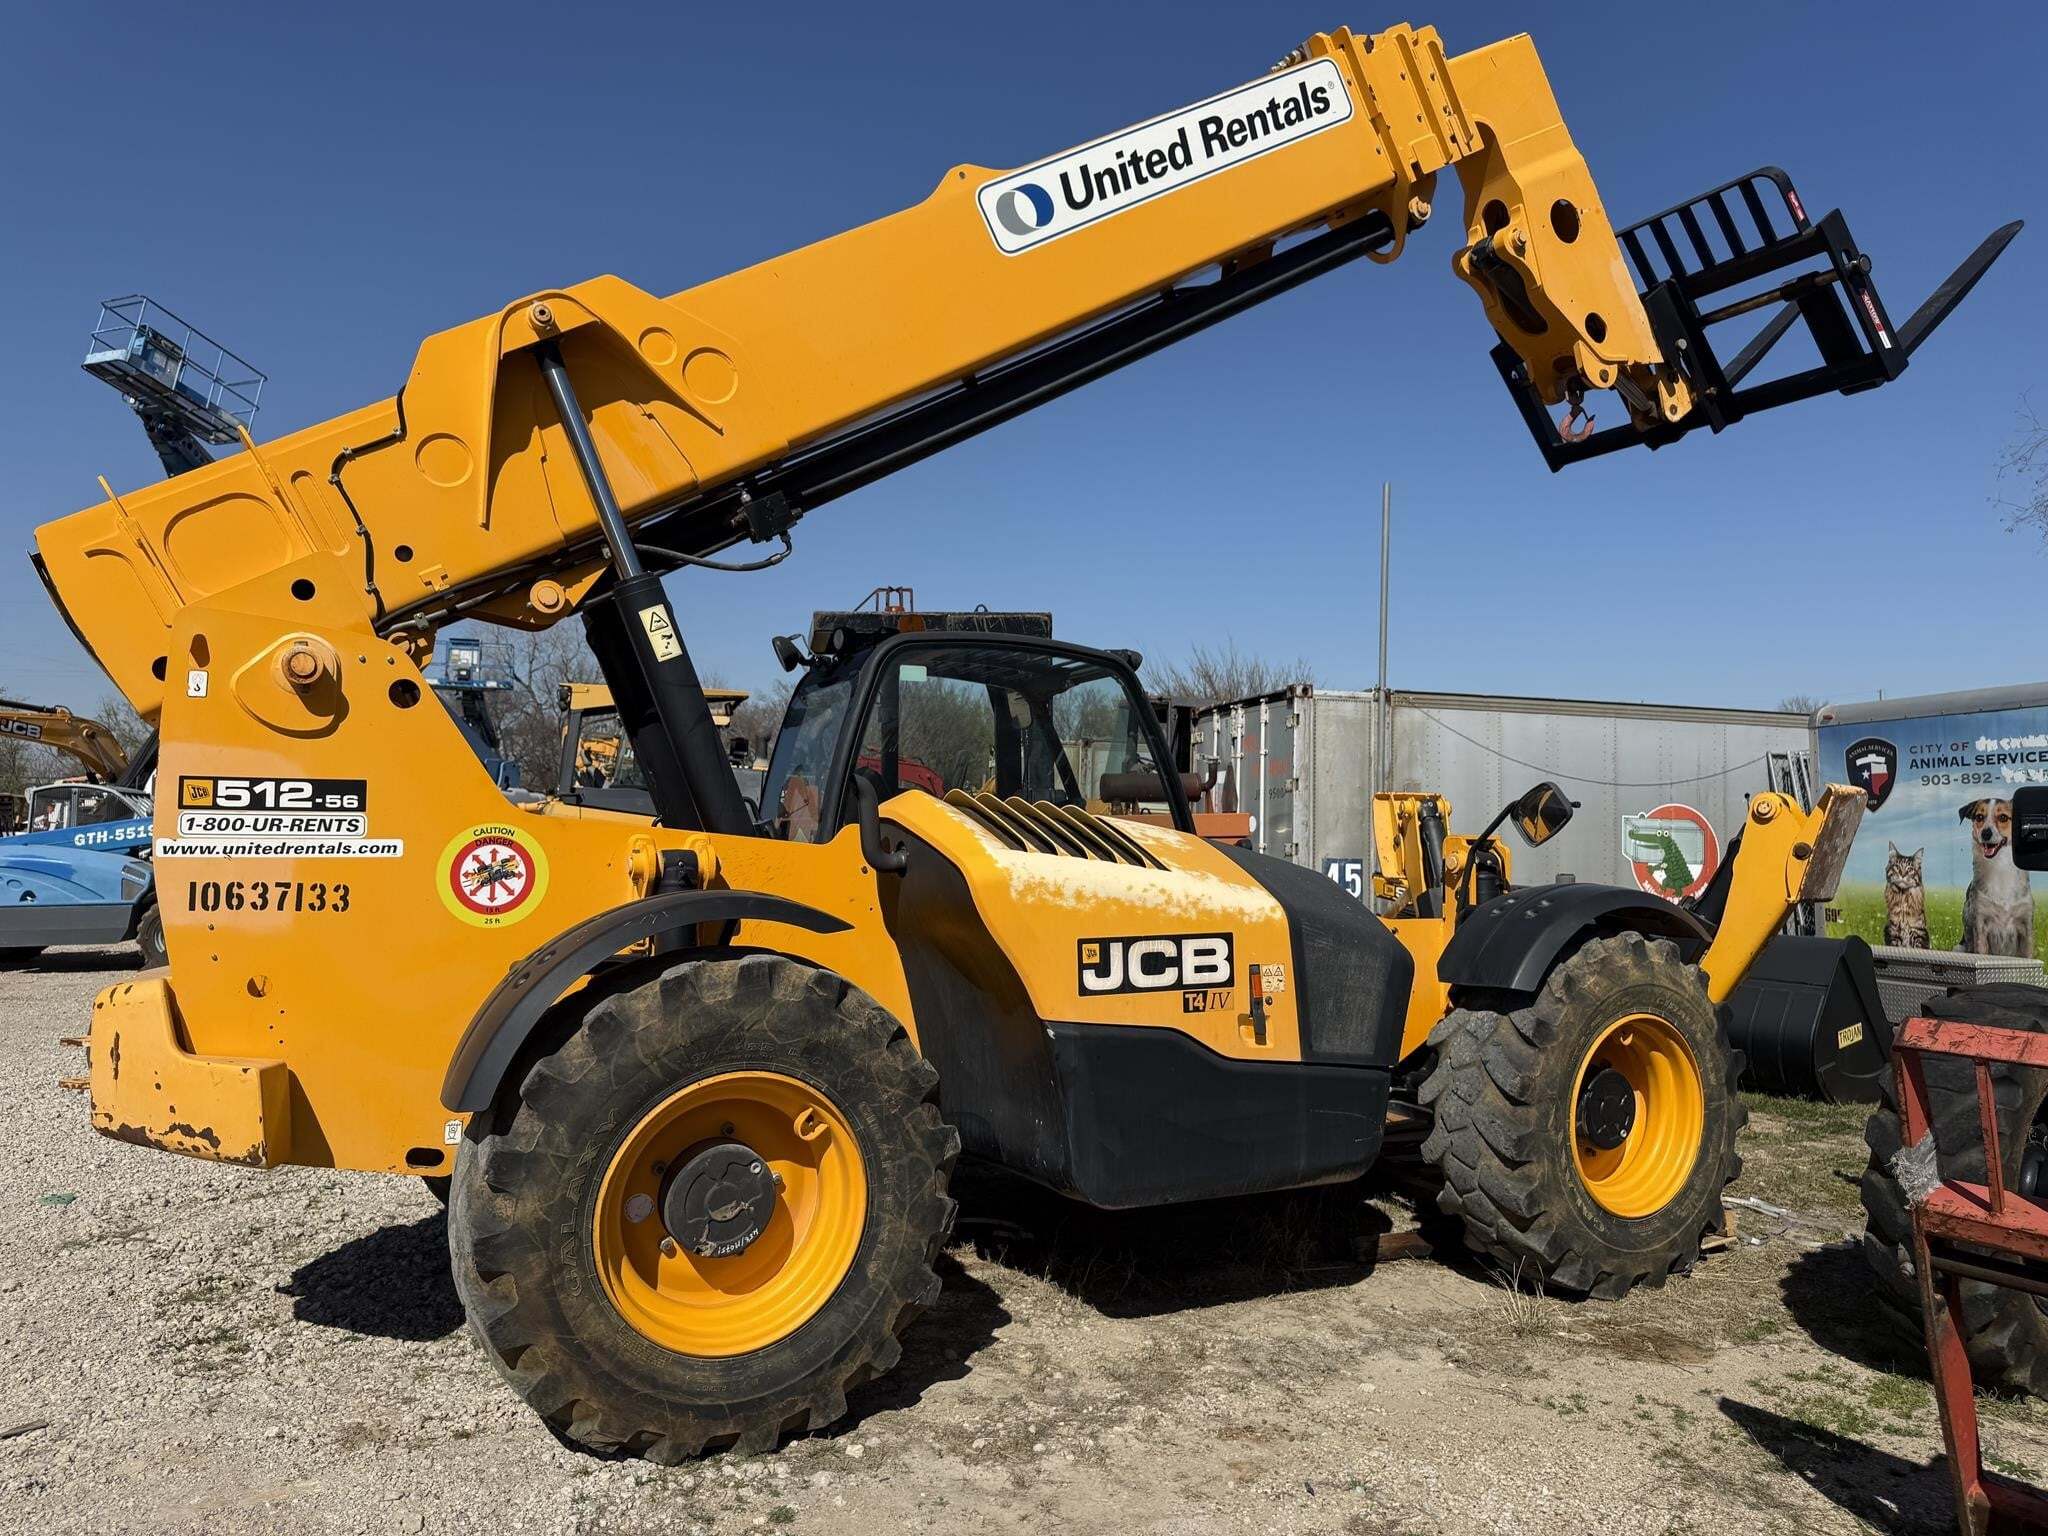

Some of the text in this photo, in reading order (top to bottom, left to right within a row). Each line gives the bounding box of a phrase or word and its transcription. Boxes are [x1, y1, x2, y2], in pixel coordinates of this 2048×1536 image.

[1059, 81, 1330, 211] United Rentals
[1, 719, 41, 739] JCB
[1909, 744, 1942, 755] CITY
[1950, 741, 1970, 752] OF
[1909, 756, 1971, 770] ANIMAL
[190, 780, 359, 809] JCB 512-56
[186, 816, 360, 833] 1-800-UR-RENTS
[473, 827, 515, 837] CAUTION
[162, 841, 398, 856] www.unitedrentals.com
[474, 837, 514, 848] DANGER
[188, 881, 350, 912] 10637133
[1082, 937, 1231, 991] JCB
[1839, 1025, 1861, 1045] TROJAN
